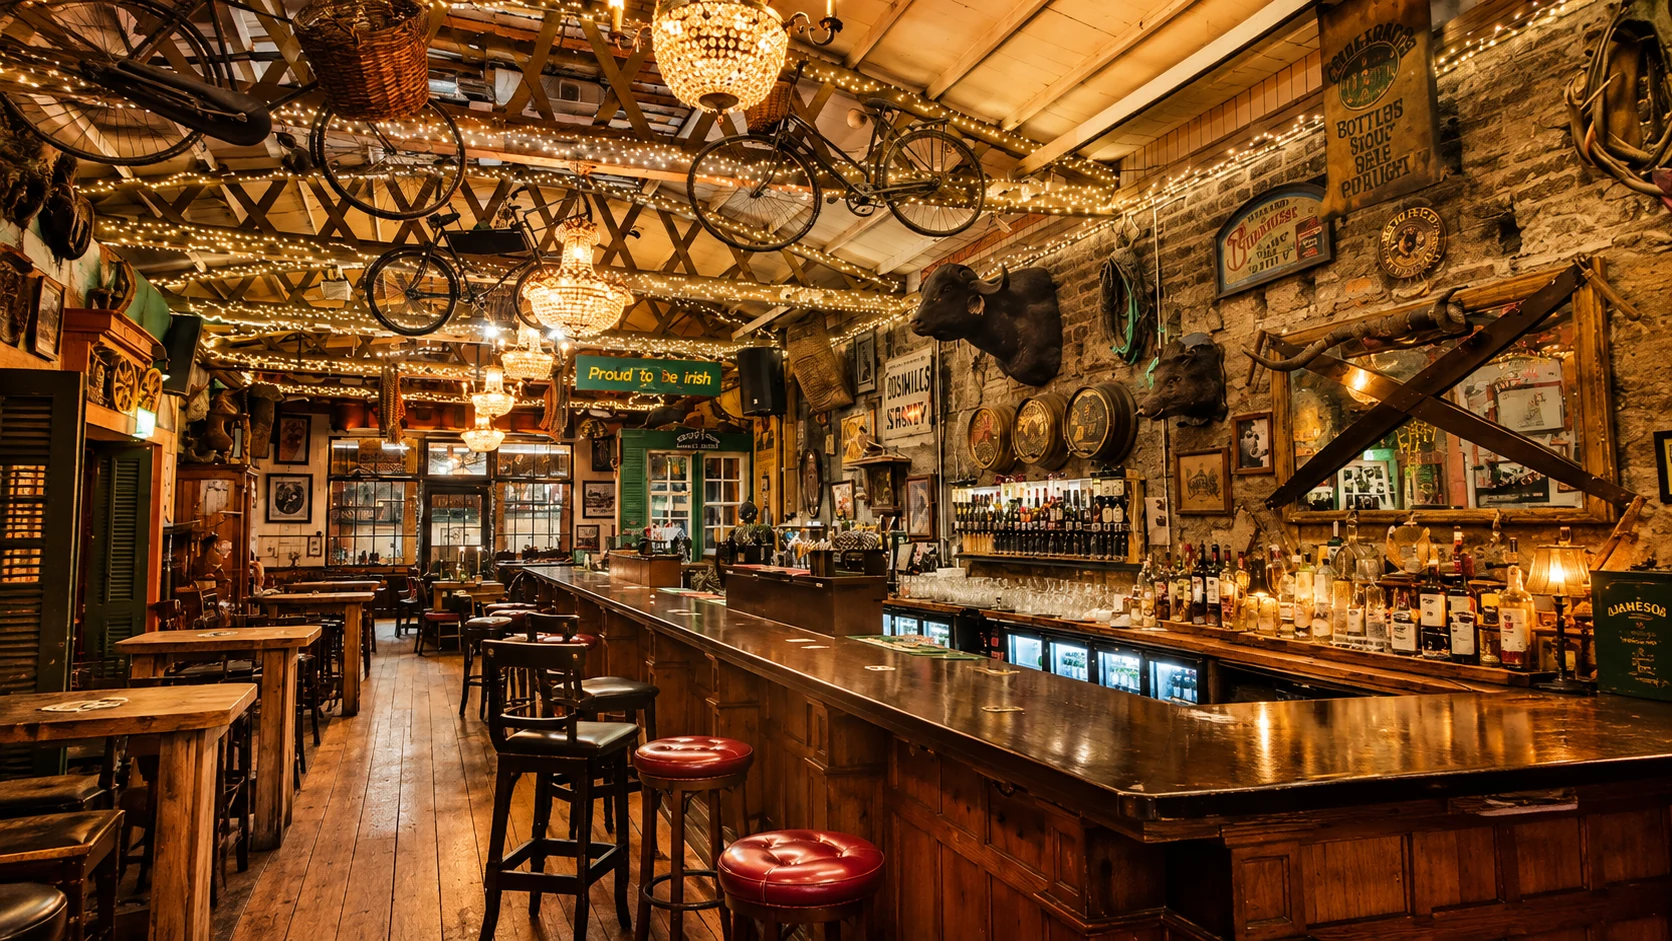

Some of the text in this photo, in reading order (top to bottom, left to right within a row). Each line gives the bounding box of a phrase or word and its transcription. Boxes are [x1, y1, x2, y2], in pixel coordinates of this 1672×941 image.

[588, 366, 633, 382] Proud
[639, 370, 654, 383] to
[684, 371, 712, 386] irish
